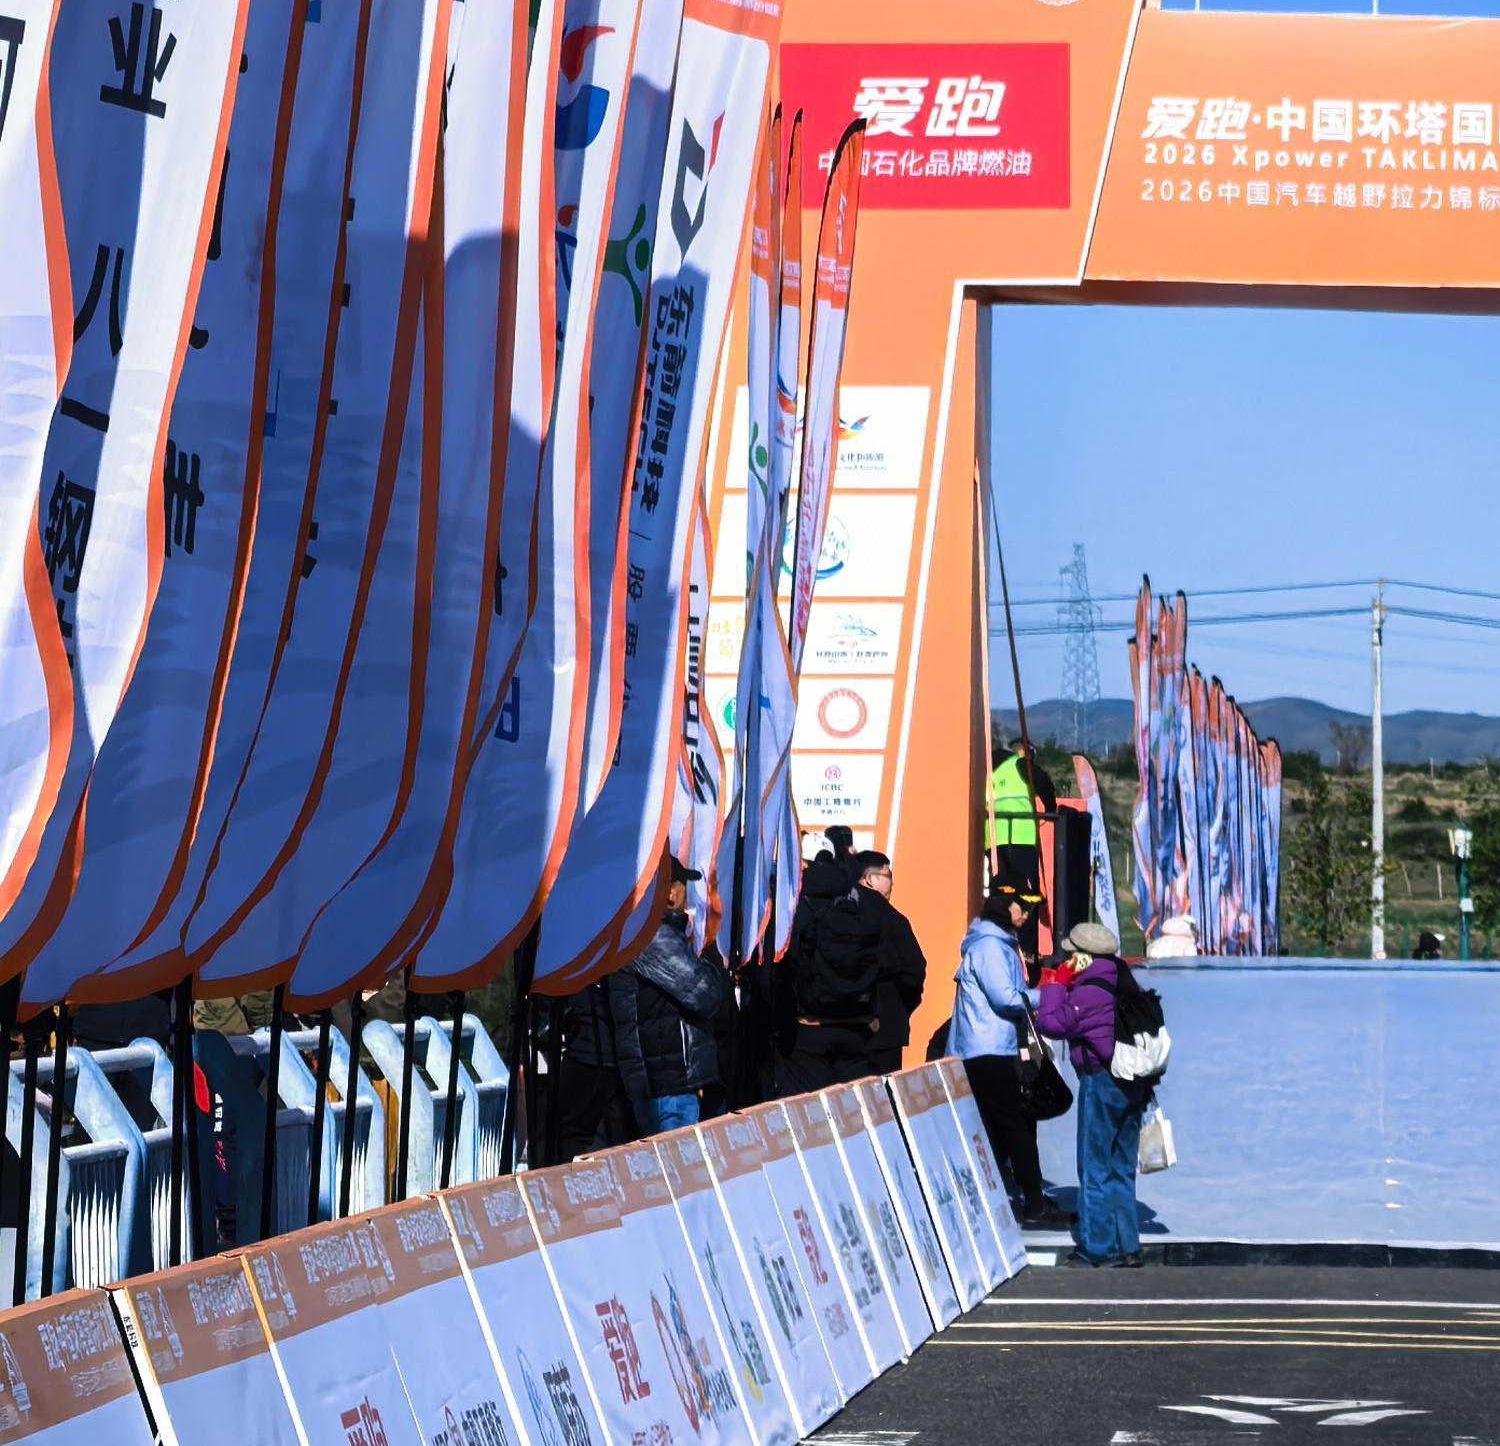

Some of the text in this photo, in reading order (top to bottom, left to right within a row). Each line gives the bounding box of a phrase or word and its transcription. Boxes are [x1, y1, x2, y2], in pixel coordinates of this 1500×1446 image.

[853, 74, 1007, 137] 爱跑
[1144, 142, 1216, 165] 2026
[1231, 148, 1349, 172] Xpower
